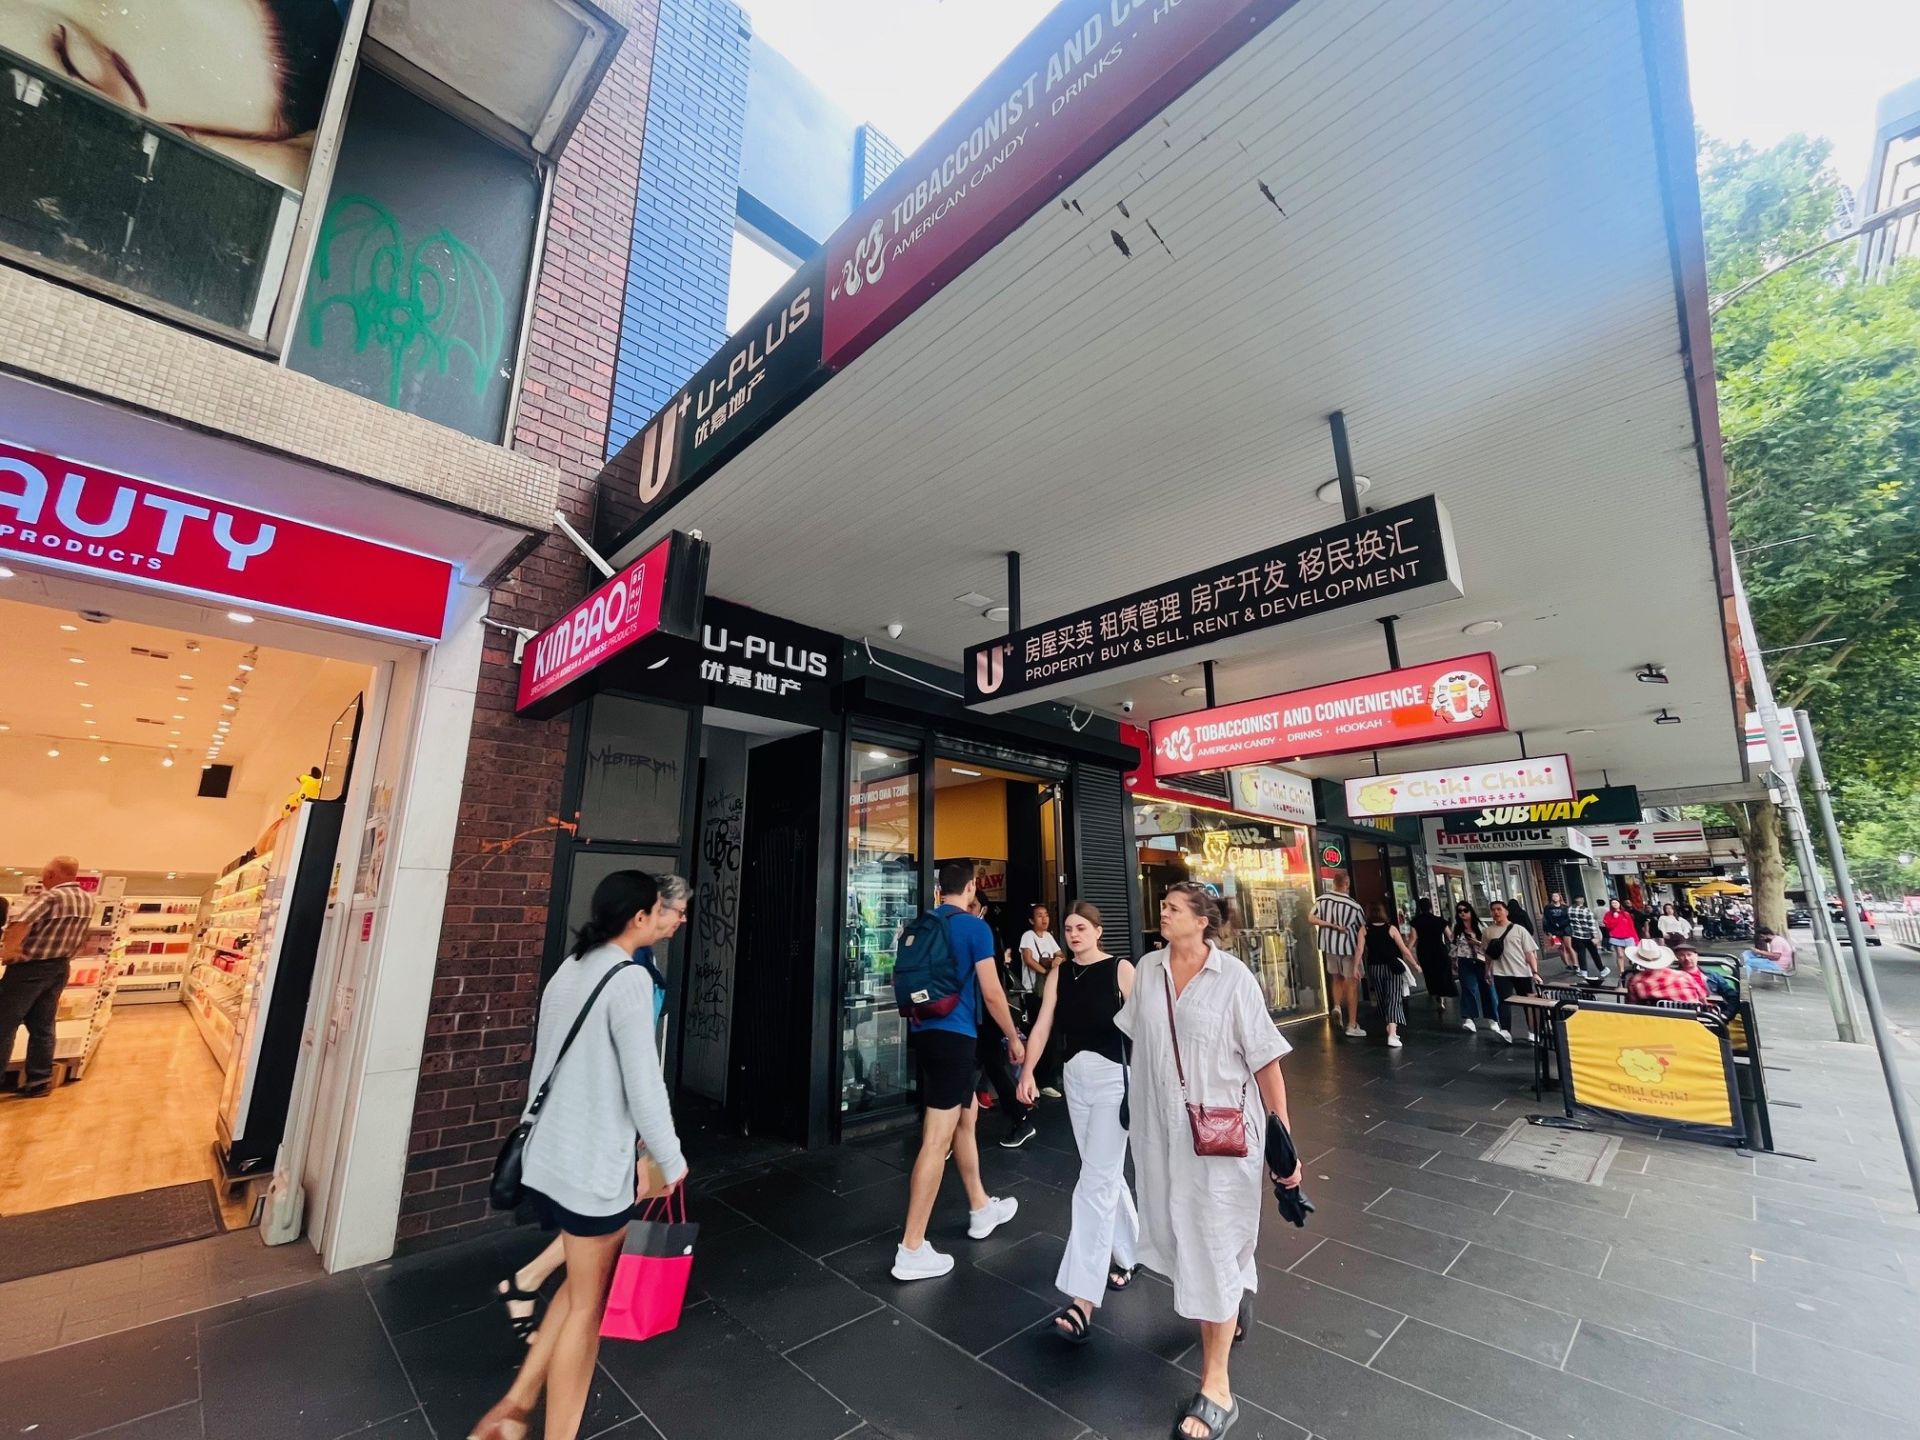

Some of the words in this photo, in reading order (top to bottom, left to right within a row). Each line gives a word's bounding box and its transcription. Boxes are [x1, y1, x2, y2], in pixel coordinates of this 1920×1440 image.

[891, 71, 1038, 234] TOBACCONIST
[1045, 13, 1102, 96] AND
[892, 188, 966, 262] AMERICAN
[970, 127, 1028, 189] CANDY
[1051, 41, 1123, 116] DRINKS
[697, 287, 811, 420] U-PLUS
[694, 368, 766, 449] 优嘉地产
[1025, 619, 1094, 664] 房屋买卖
[1099, 592, 1182, 641] 租赁管理
[1191, 559, 1289, 615] 房产开发
[1297, 518, 1419, 584] 移民换汇
[1025, 652, 1095, 682] PROPERTY
[1101, 642, 1130, 661] BUY
[1133, 639, 1142, 652] &
[1146, 628, 1189, 649] SELL,
[1193, 611, 1239, 636] RENT
[1244, 607, 1256, 622] &
[1260, 560, 1420, 618] DEVELOPMENT
[701, 659, 802, 696] 优嘉地产
[702, 624, 827, 677] U-PLUS
[1194, 711, 1280, 744] TOBACCONIST
[1283, 706, 1312, 726] AND
[1315, 684, 1426, 722] CONVENIENCE
[1197, 741, 1243, 757] AMERICAN
[1243, 736, 1277, 750] CANDY
[1287, 728, 1323, 742] DRINKS
[1335, 718, 1383, 734] HOOKAH
[1407, 775, 1472, 798] Chiki
[1481, 766, 1553, 791] Chiki
[1474, 794, 1600, 829] SUBWAY
[1465, 841, 1524, 851] TOBACCONIST
